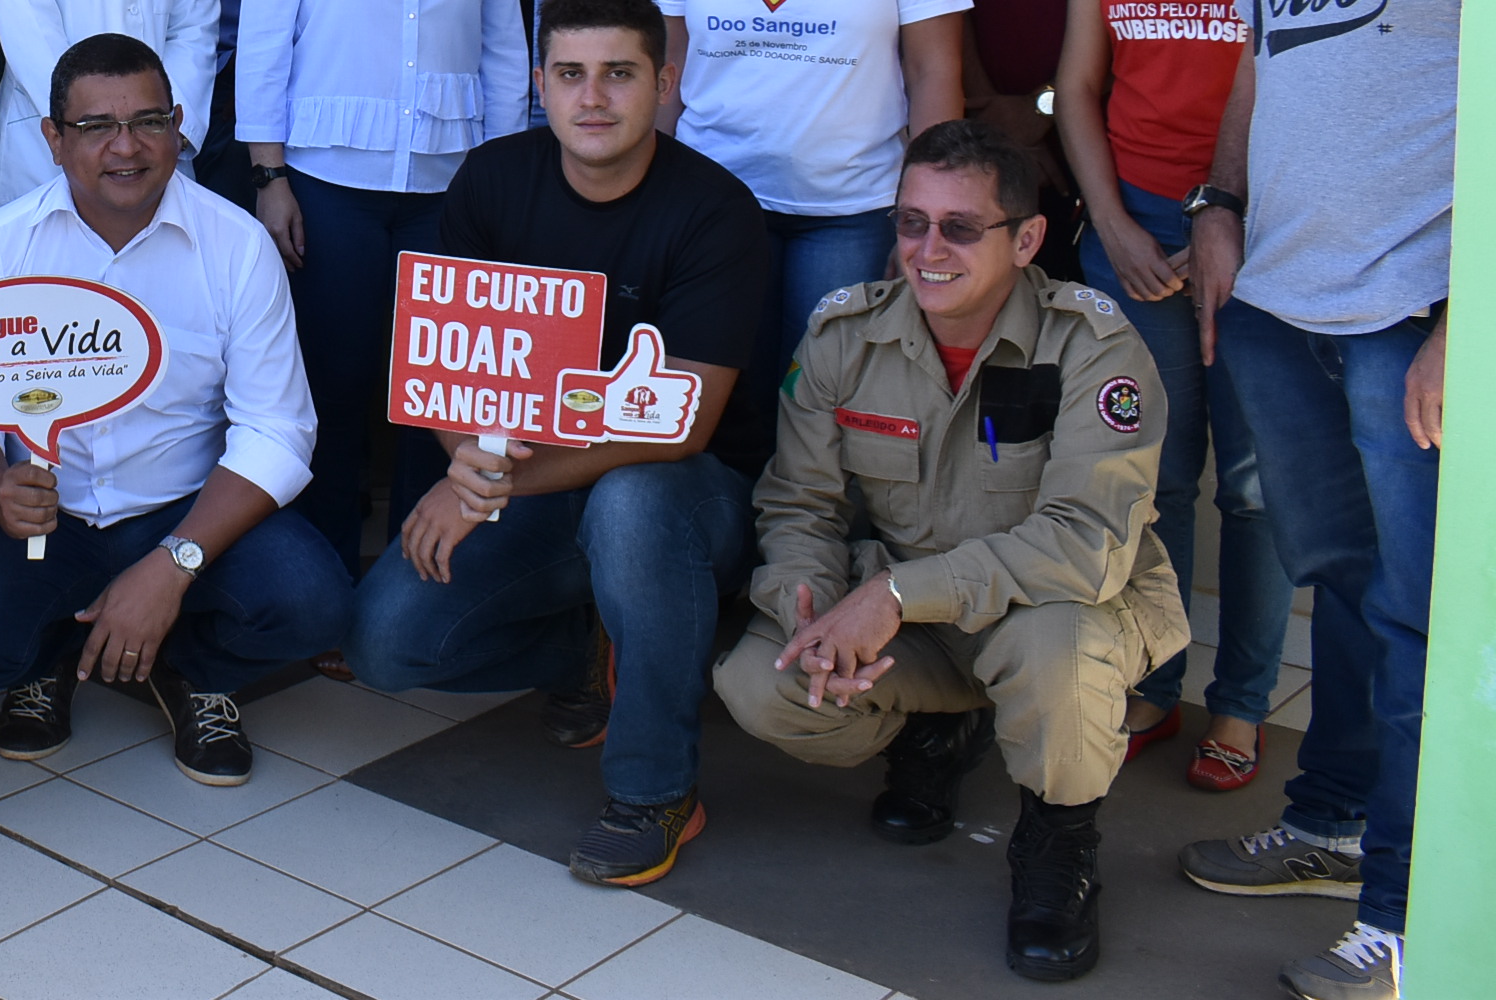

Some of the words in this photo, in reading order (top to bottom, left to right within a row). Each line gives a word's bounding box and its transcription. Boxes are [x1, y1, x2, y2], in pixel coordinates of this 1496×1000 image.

[1107, 3, 1157, 19] JUNTOS
[1160, 3, 1198, 17] PELO
[1200, 3, 1225, 18] FIM
[707, 15, 746, 31] Doo
[751, 17, 837, 37] Sangue!
[1110, 18, 1249, 43] TUBERCULOSE
[762, 40, 807, 51] Novembro
[764, 51, 802, 62] DOADOR
[804, 55, 816, 63] DE
[818, 56, 858, 66] SANGUE
[411, 262, 456, 305] EU
[466, 269, 586, 319] CURTO
[11, 339, 27, 356] a
[40, 318, 123, 356] Vida
[407, 316, 533, 380] DOAR
[11, 373, 20, 382] a
[25, 368, 62, 382] Seiva
[67, 366, 86, 378] da
[91, 363, 129, 377] Vida"
[403, 377, 544, 433] SANGUE
[900, 425, 917, 434] A+
